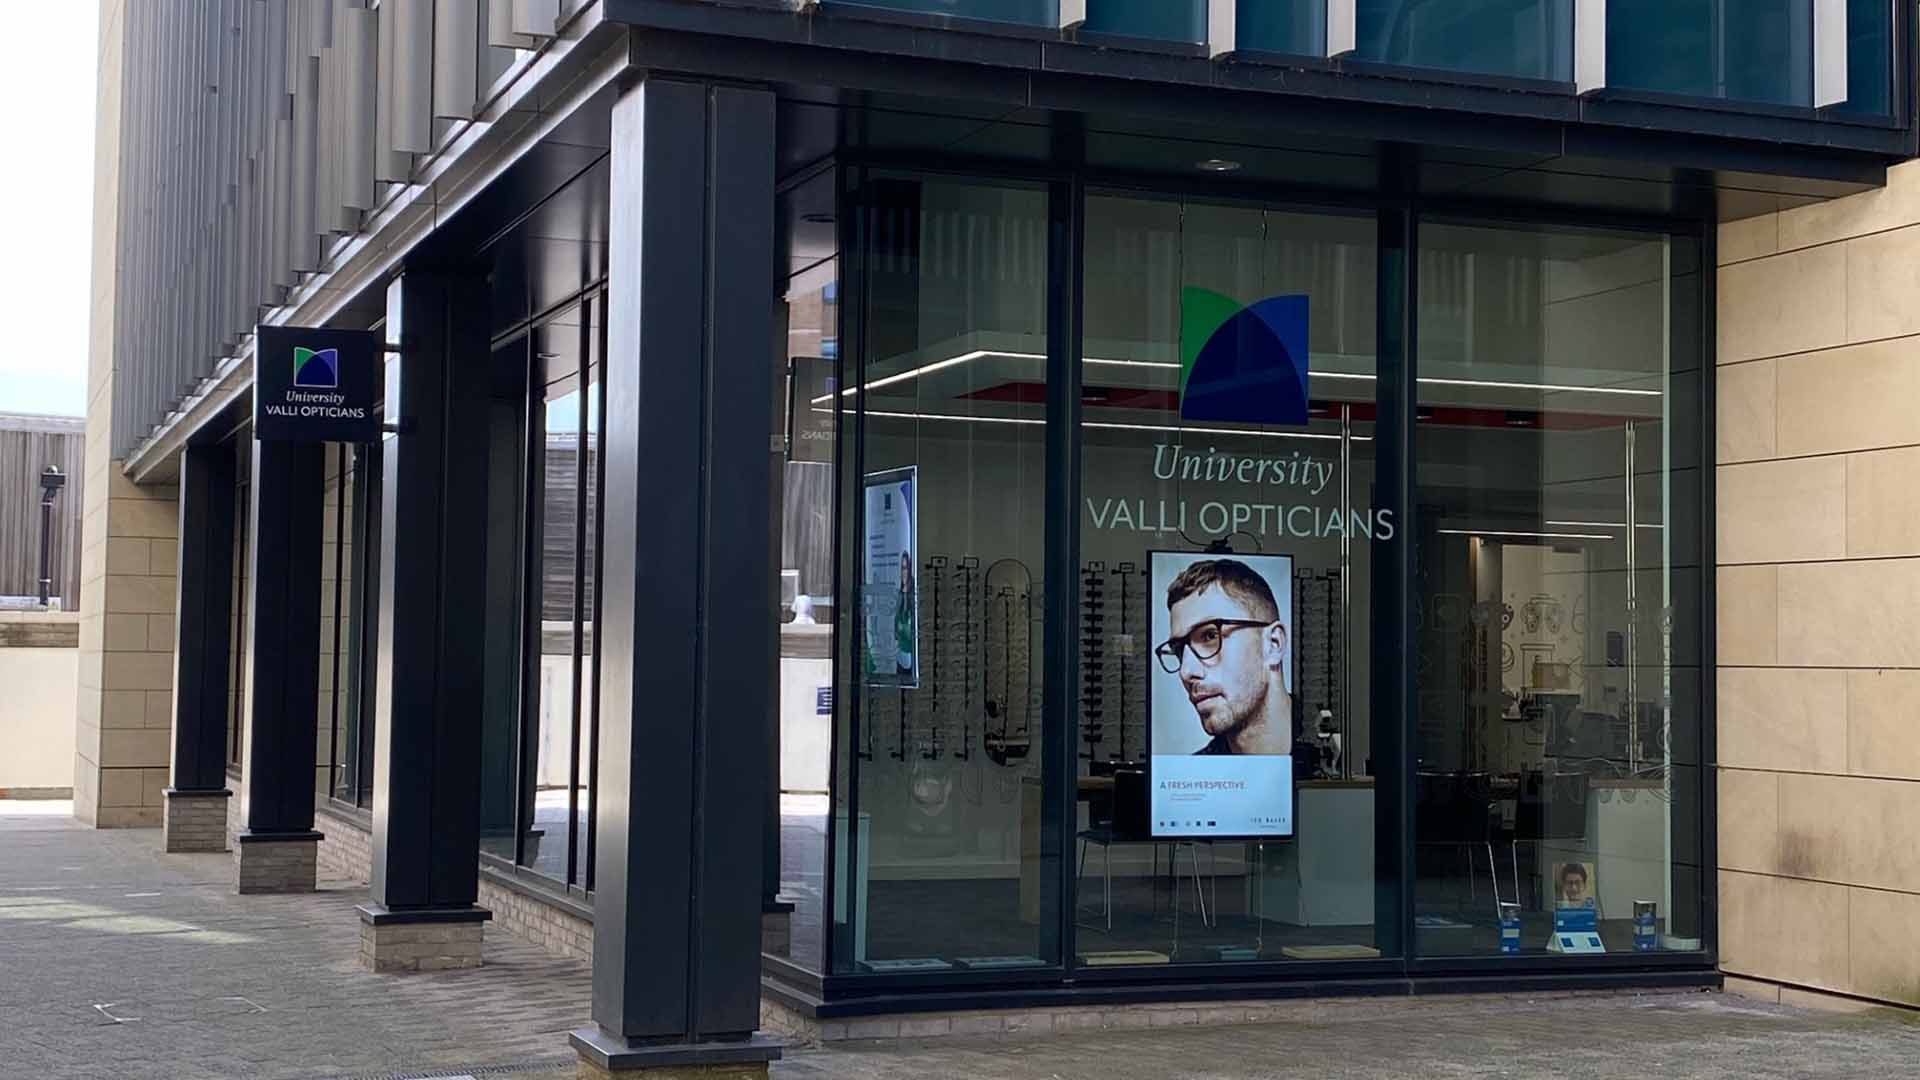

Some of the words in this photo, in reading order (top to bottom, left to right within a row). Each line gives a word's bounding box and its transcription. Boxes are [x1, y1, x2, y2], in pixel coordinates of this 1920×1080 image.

[286, 390, 344, 405] University
[265, 405, 298, 416] VALLI
[300, 406, 365, 418] OPTICIANS
[1153, 445, 1333, 494] University
[1086, 498, 1186, 532] VALLI
[1199, 502, 1394, 540] OPTICIANS
[1160, 781, 1167, 789] A
[1168, 781, 1193, 790] FRESH
